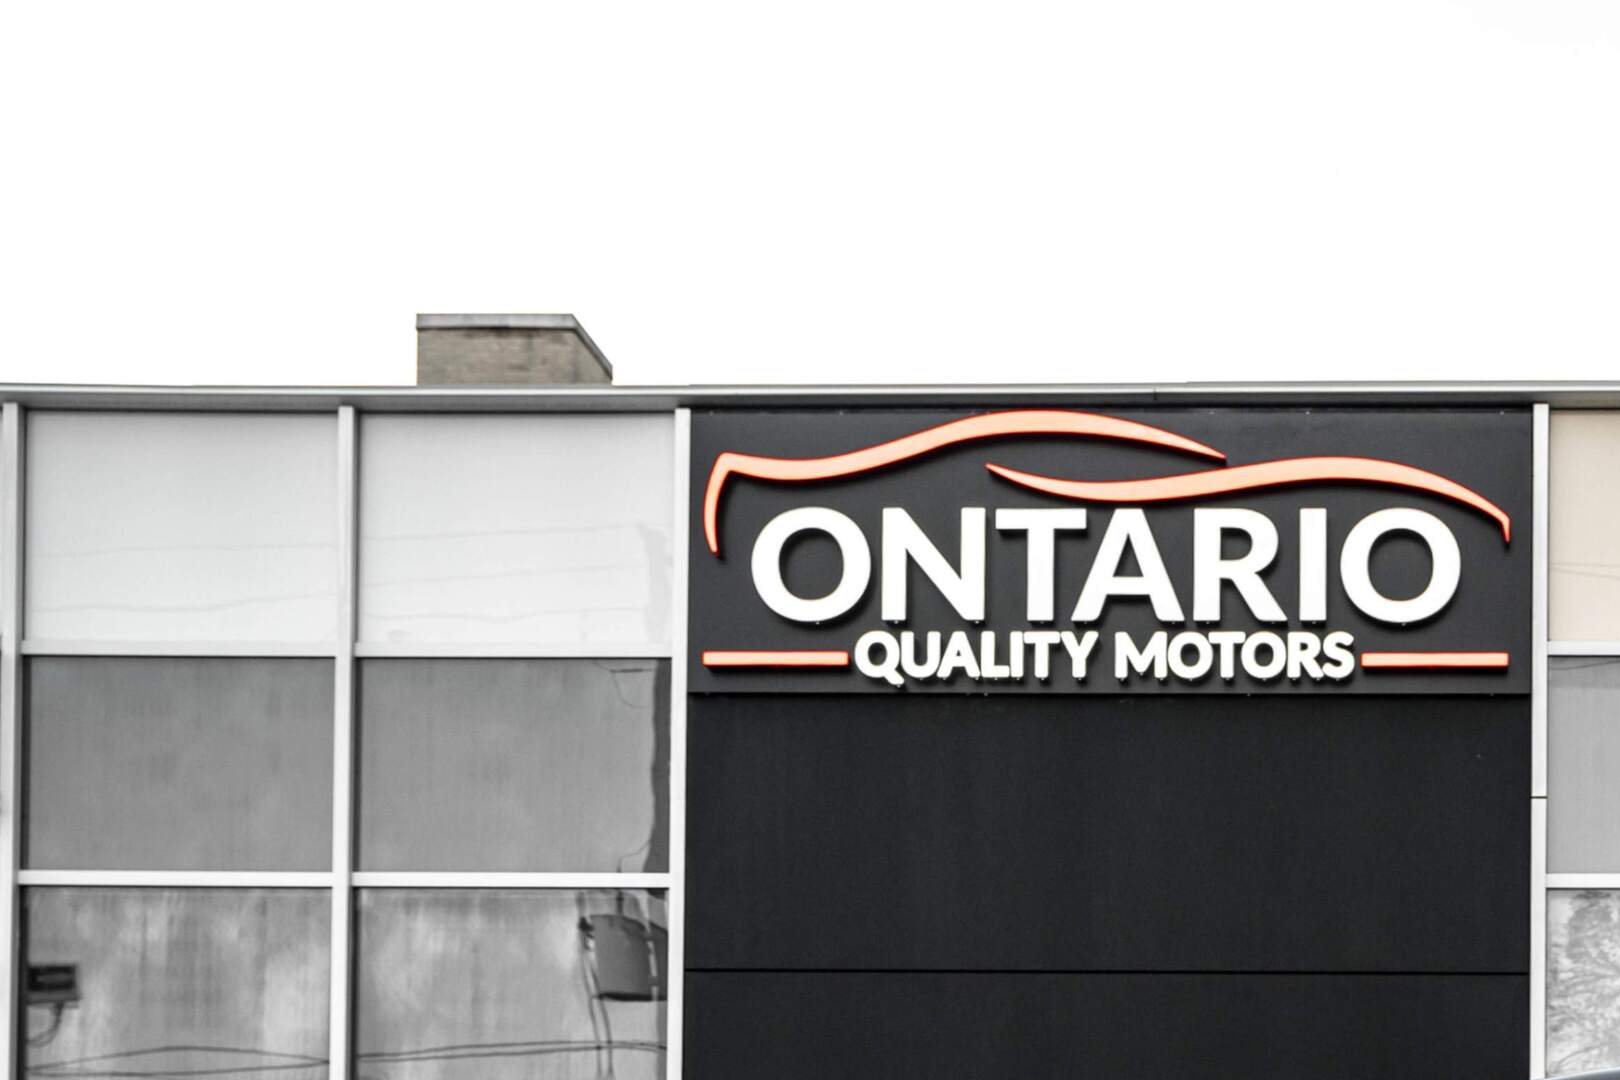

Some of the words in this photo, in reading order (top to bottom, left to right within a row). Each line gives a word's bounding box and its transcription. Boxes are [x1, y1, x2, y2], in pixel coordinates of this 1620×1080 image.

[750, 506, 1461, 623] ONTARIO
[854, 630, 1099, 687] QUALITY
[1114, 630, 1355, 680] MOTORS
